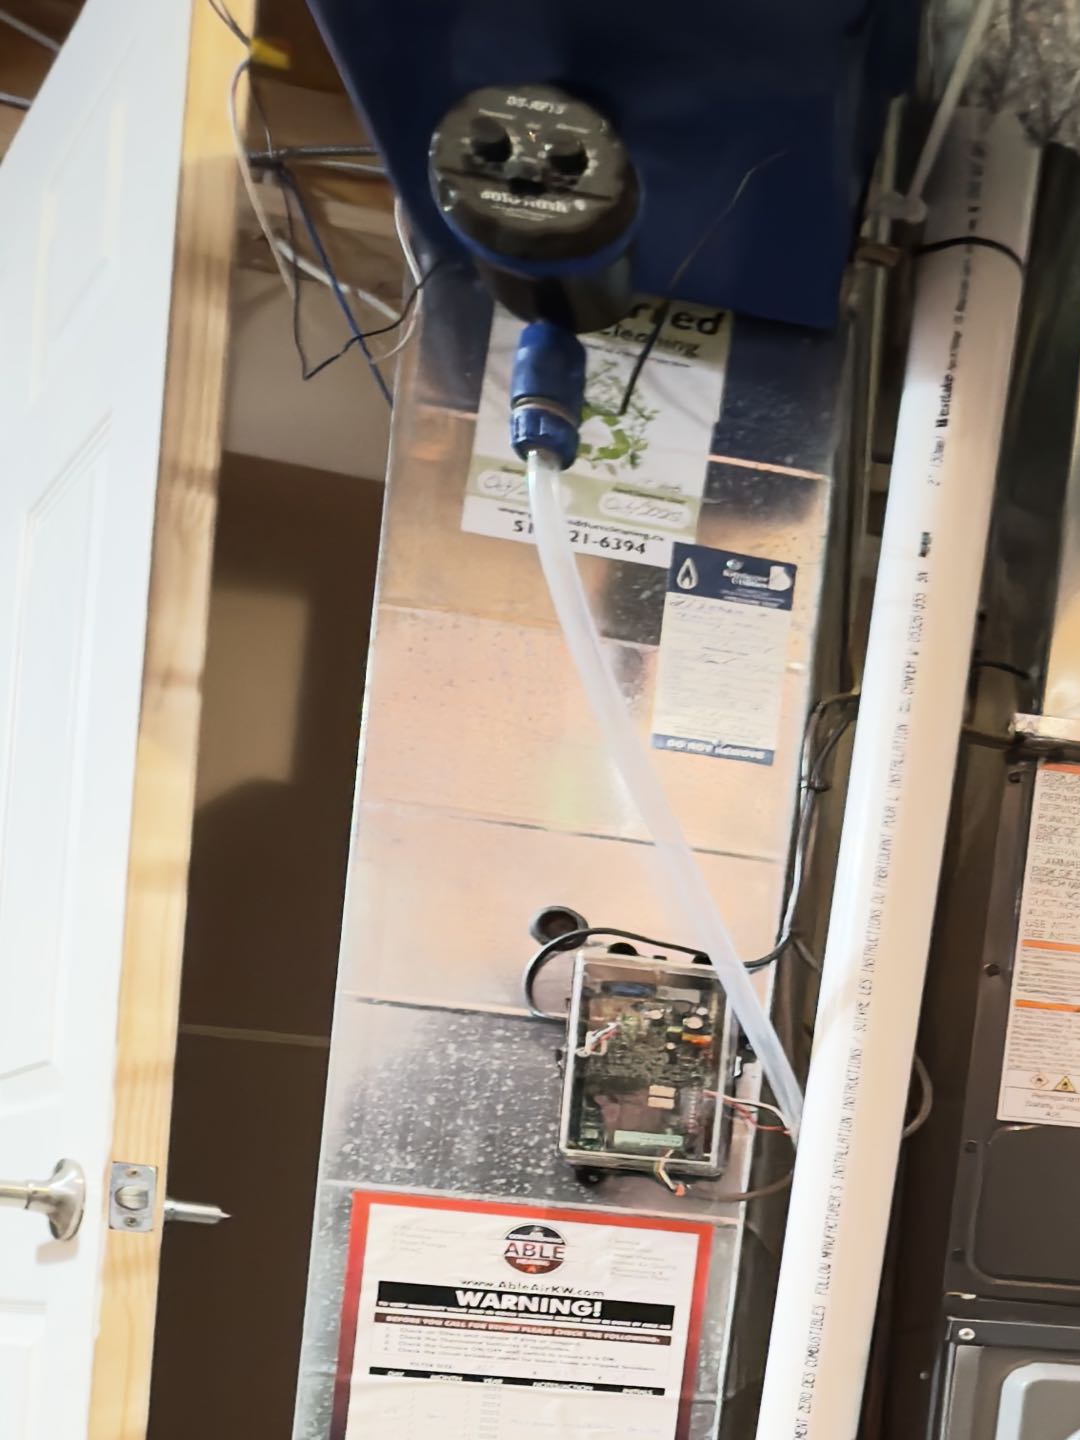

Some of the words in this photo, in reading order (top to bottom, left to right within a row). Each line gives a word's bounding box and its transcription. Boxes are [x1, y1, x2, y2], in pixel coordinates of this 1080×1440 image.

[511, 519, 648, 555] 5121-6394
[504, 1242, 566, 1260] ABLE
[460, 1278, 606, 1298] www.AbleAirKW.com
[455, 1290, 603, 1317] WARNING!
[802, 1303, 828, 1368] COMBUSTIBLES
